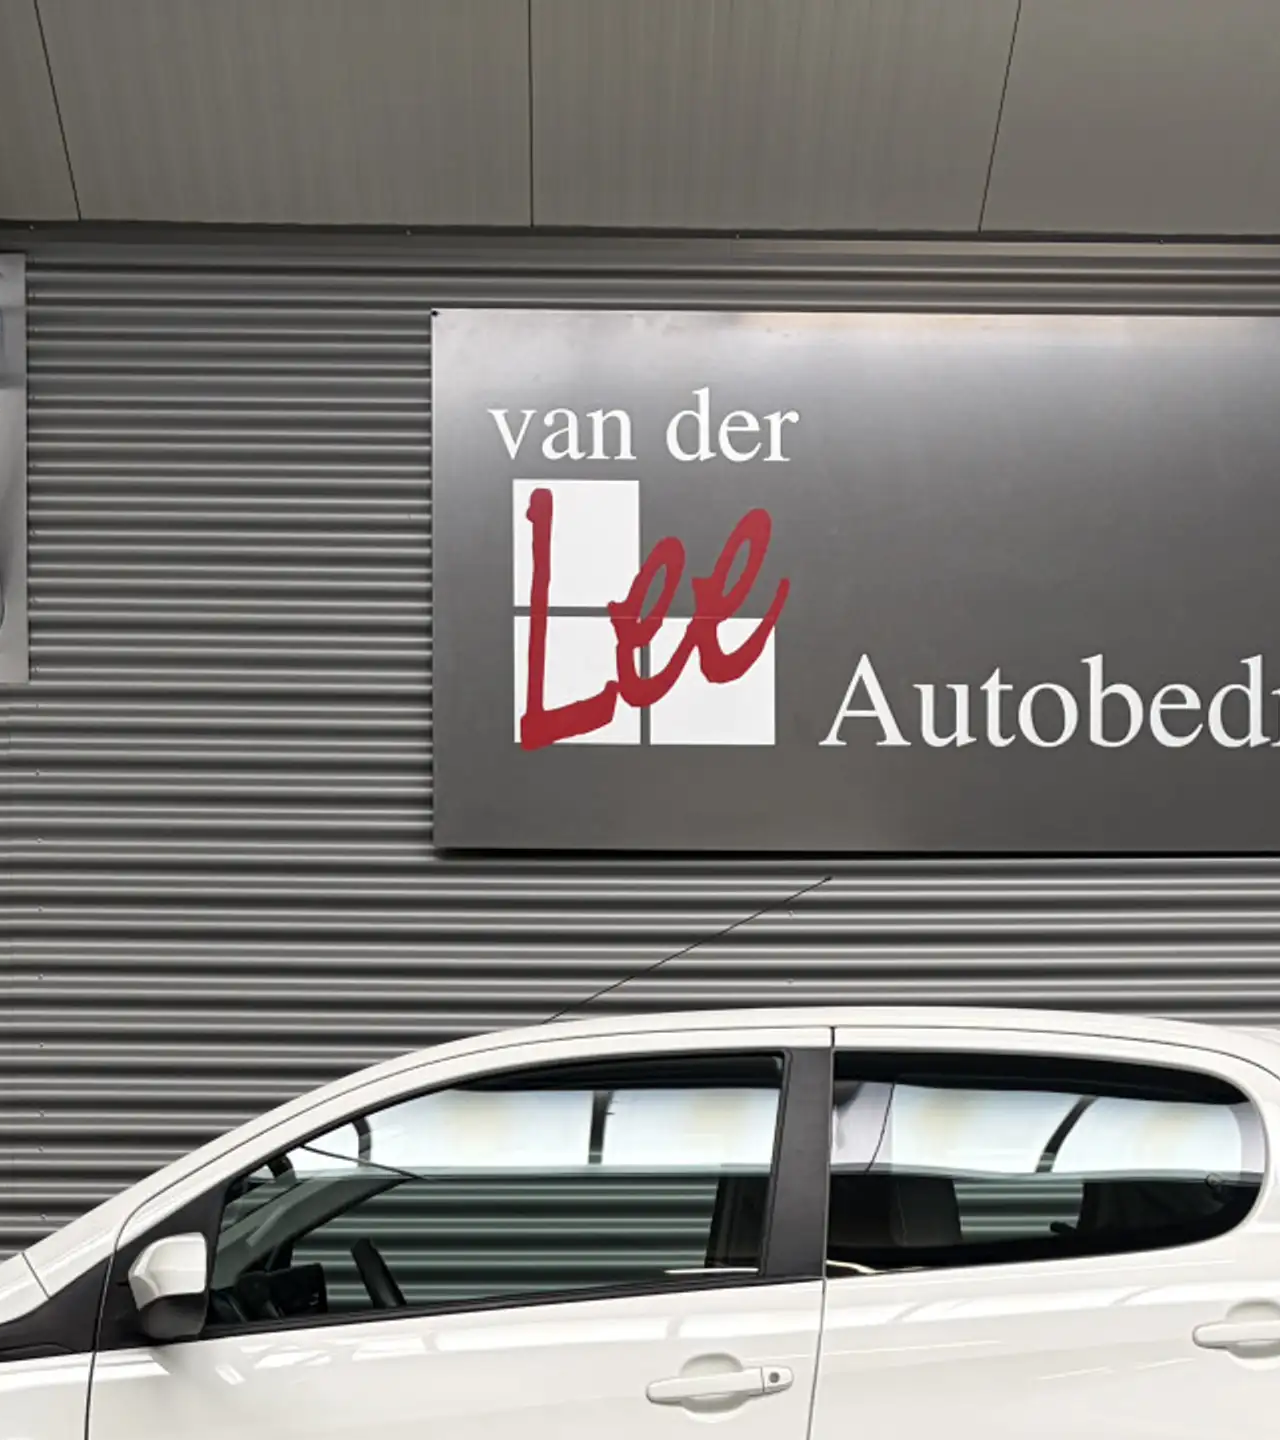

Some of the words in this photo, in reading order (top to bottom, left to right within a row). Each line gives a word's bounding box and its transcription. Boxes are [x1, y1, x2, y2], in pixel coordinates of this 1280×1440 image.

[487, 407, 637, 461] van
[666, 386, 800, 462] der
[520, 487, 790, 751] Lee
